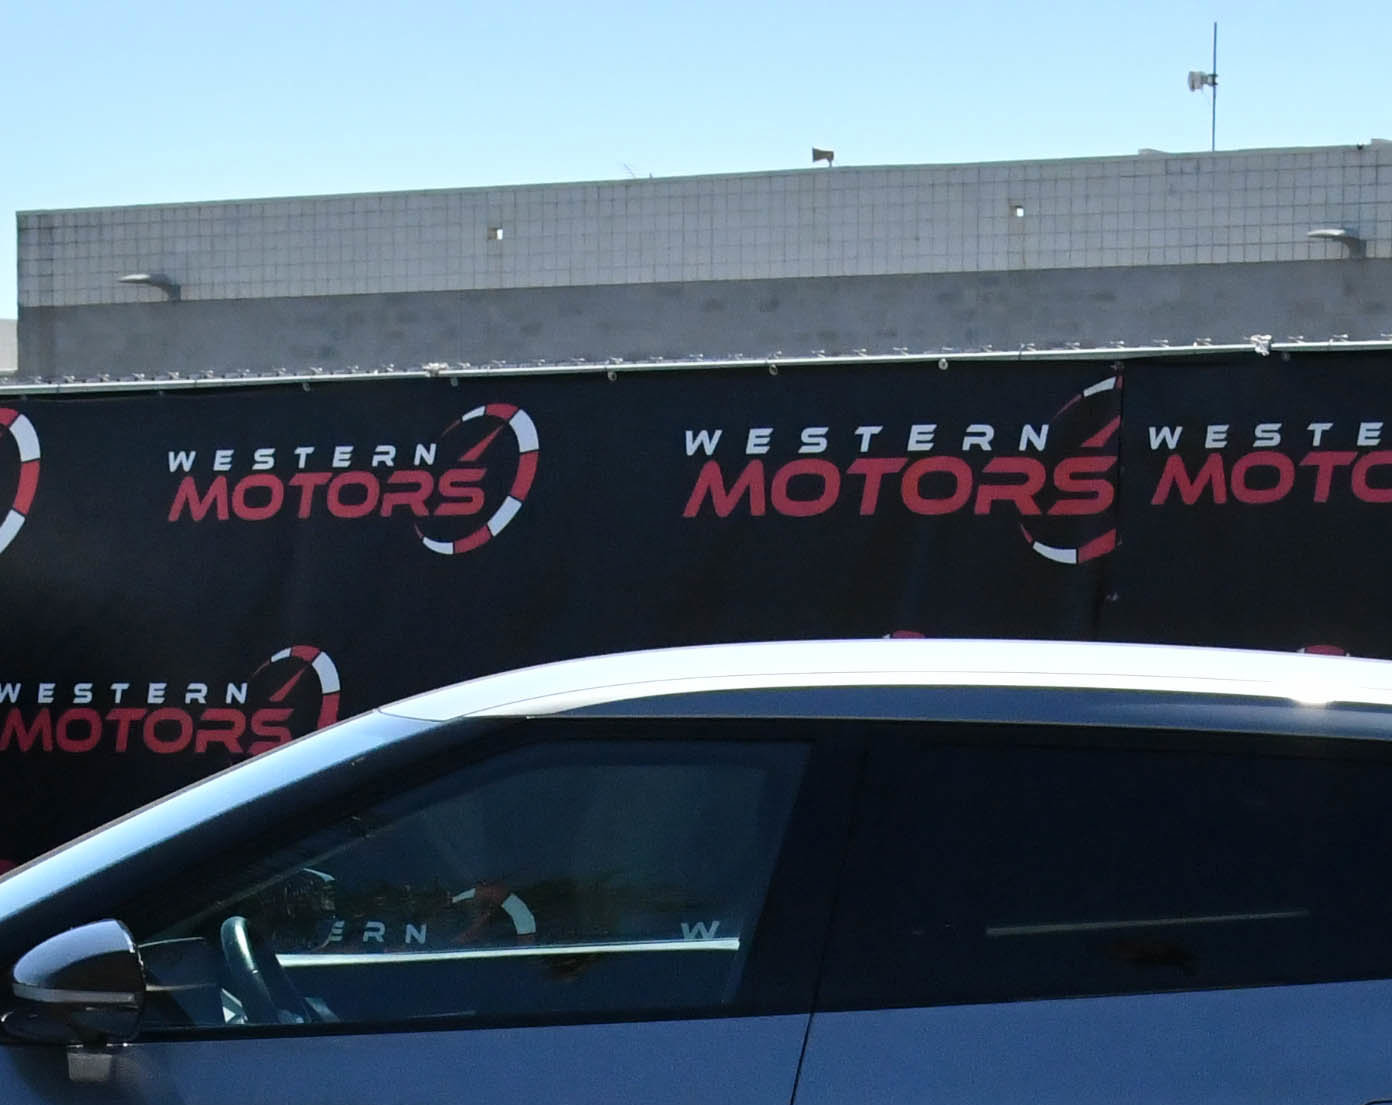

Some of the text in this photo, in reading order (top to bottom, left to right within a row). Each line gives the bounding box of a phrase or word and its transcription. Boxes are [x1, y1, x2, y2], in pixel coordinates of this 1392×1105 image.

[168, 443, 437, 473] WESTERN
[685, 424, 1049, 456] WESTERN
[167, 467, 486, 521] MOTORS
[682, 455, 1117, 518] MOTORS
